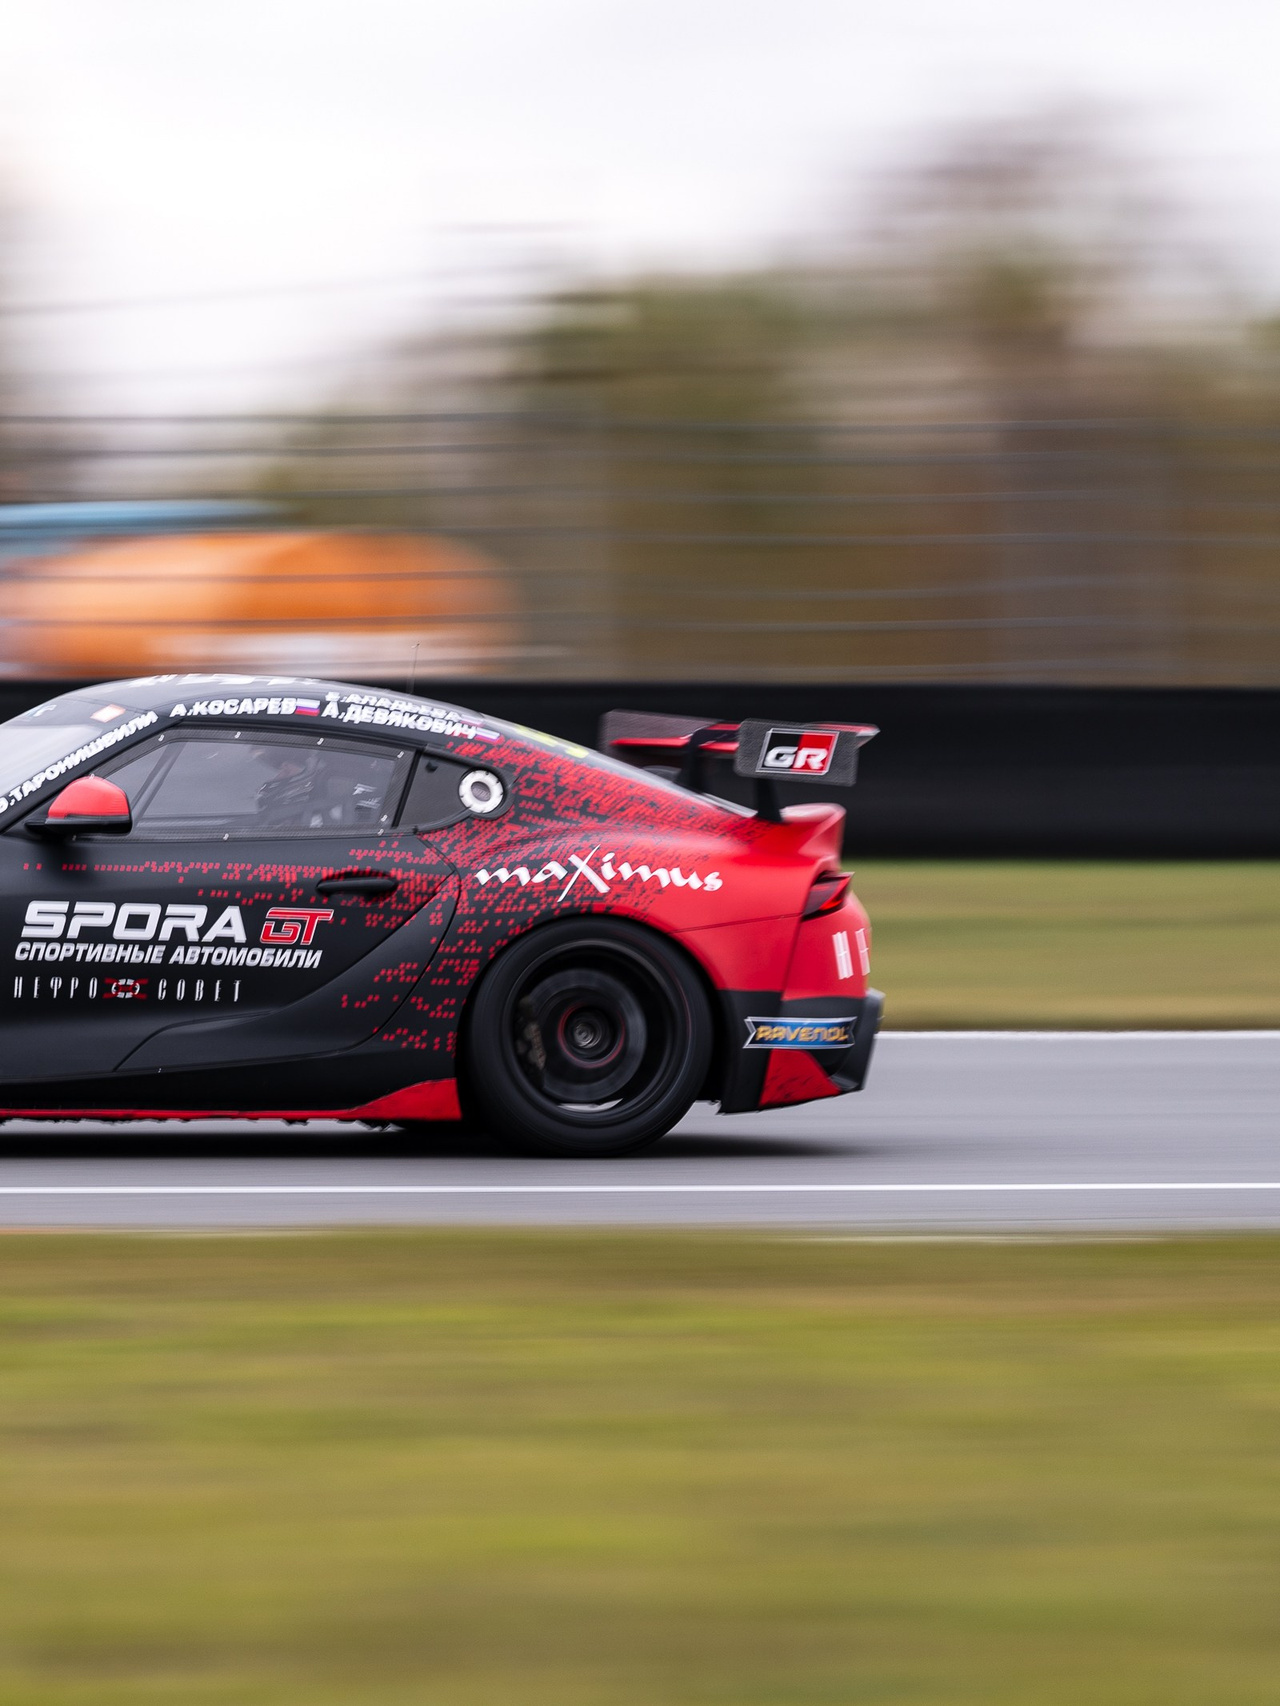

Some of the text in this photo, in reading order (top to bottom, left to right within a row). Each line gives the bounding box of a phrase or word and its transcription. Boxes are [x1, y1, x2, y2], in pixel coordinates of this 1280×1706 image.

[170, 698, 297, 717] А.КОСАРЕВ
[321, 701, 477, 739] А.ДЕВЯКОВИЧ
[764, 746, 828, 770] GR
[21, 900, 335, 946] SPORA GT
[15, 941, 323, 969] СПОРТИВНЫЕ АВТОМОБИЛИ
[157, 978, 242, 1002] СОВЕТ
